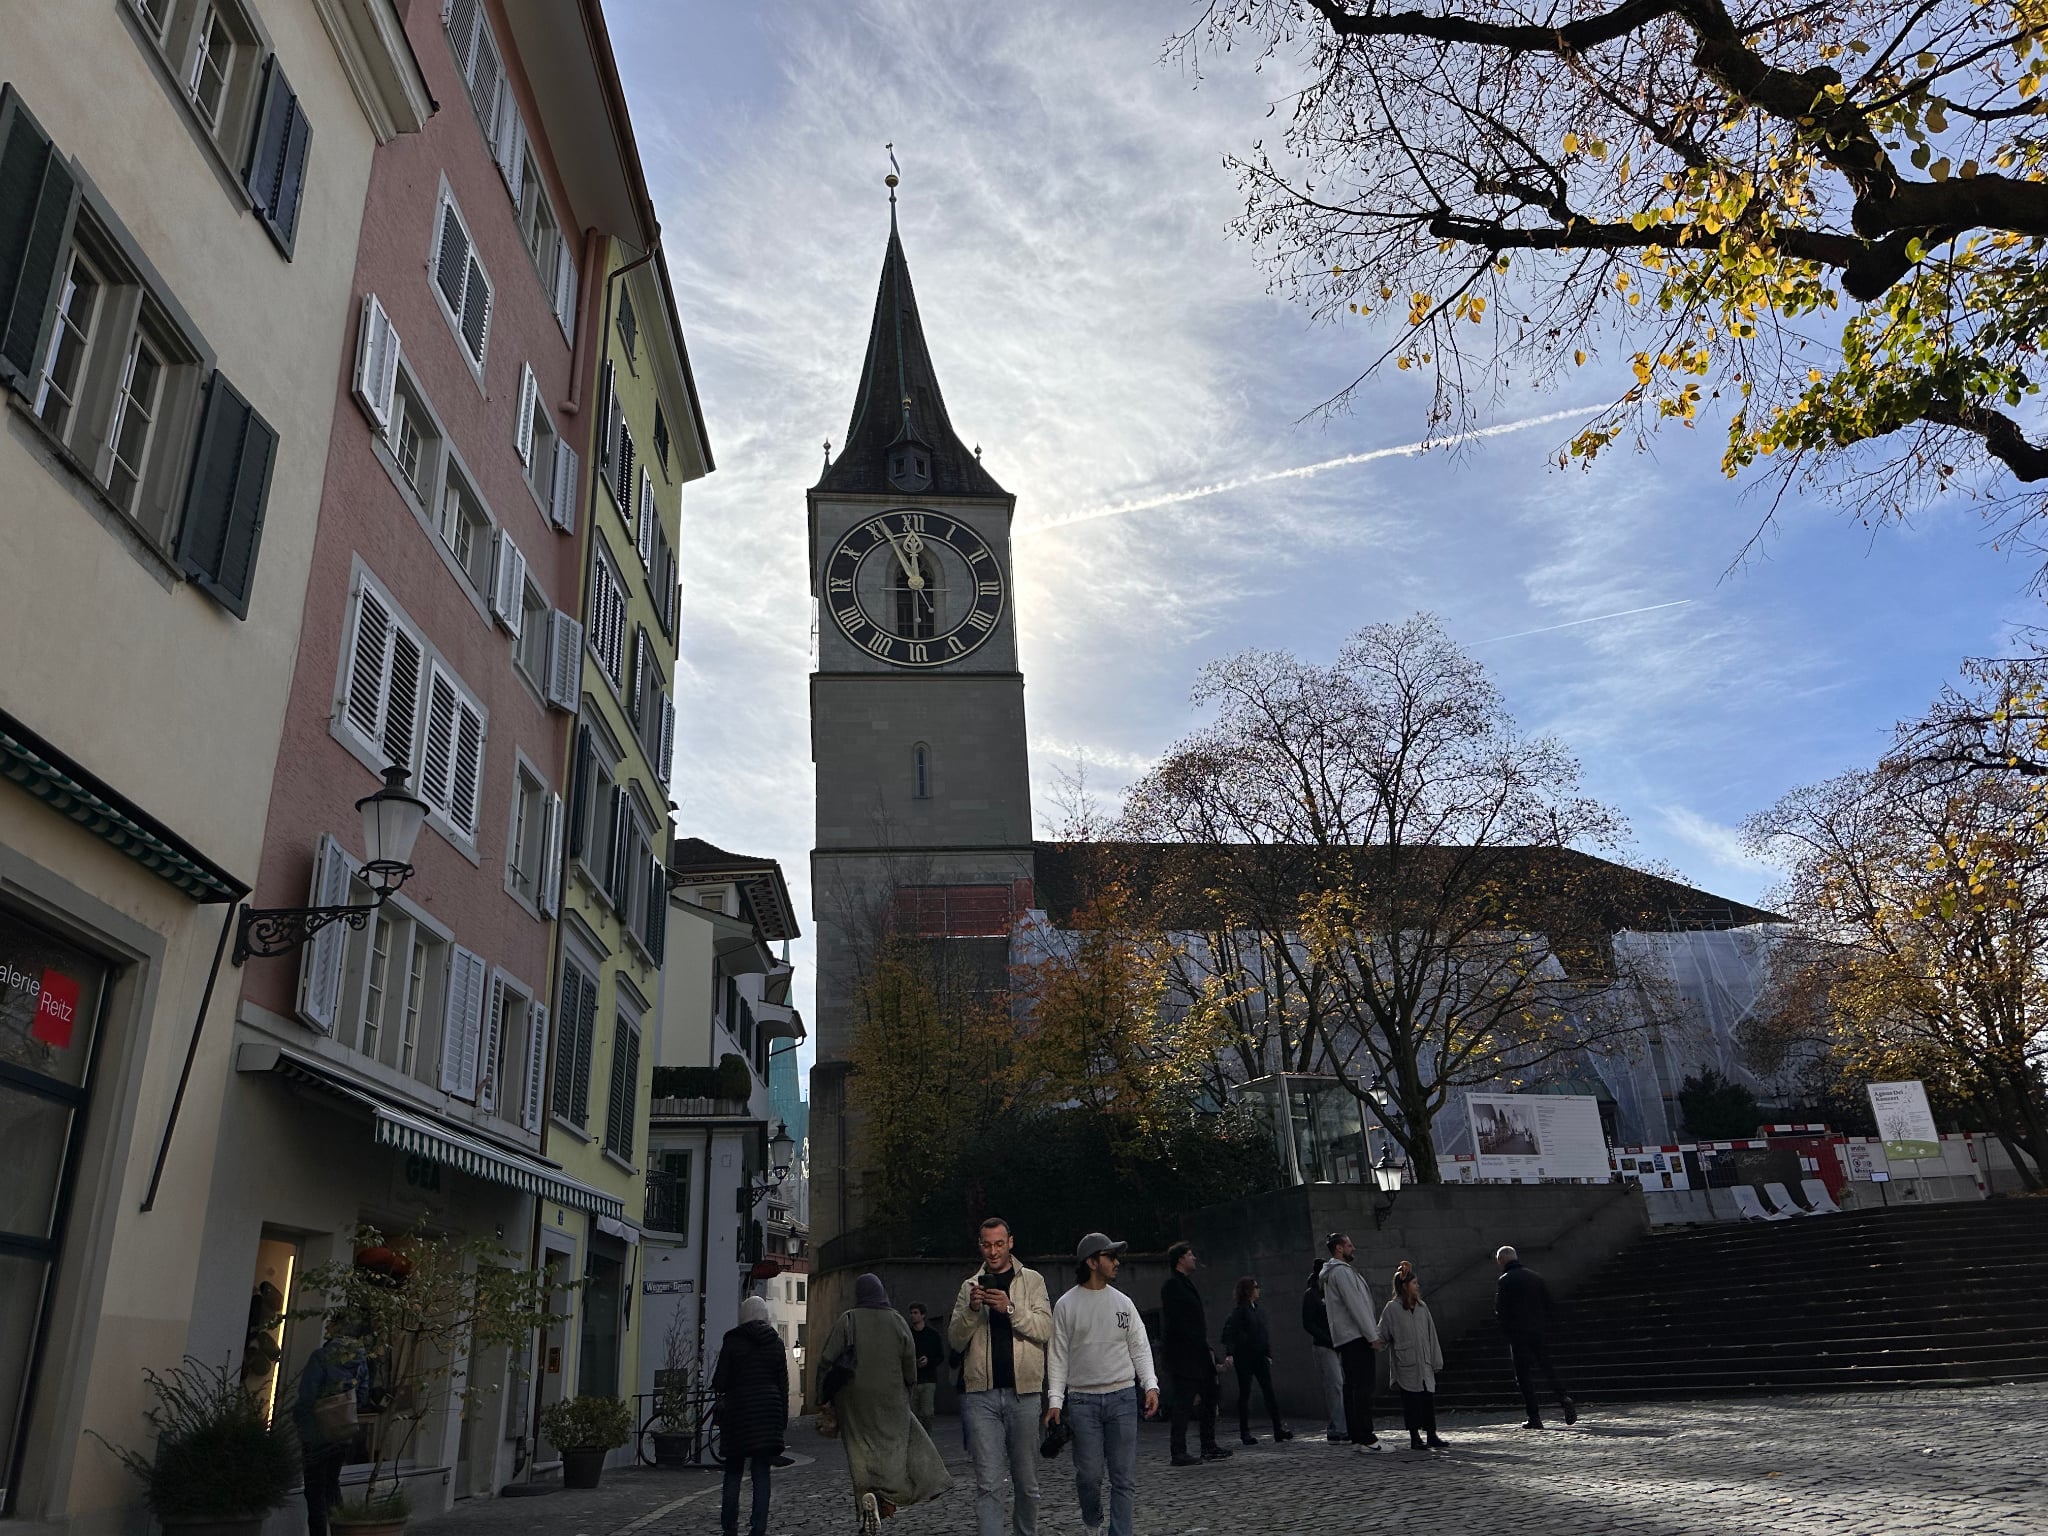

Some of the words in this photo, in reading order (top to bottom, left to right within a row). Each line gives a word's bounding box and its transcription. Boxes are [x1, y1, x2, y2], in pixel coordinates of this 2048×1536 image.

[901, 514, 926, 532] XII
[840, 544, 862, 561] X
[968, 548, 989, 565] II
[830, 577, 852, 593] IX
[979, 580, 1000, 596] III
[908, 643, 929, 662] VI
[40, 991, 73, 1022] Reitz
